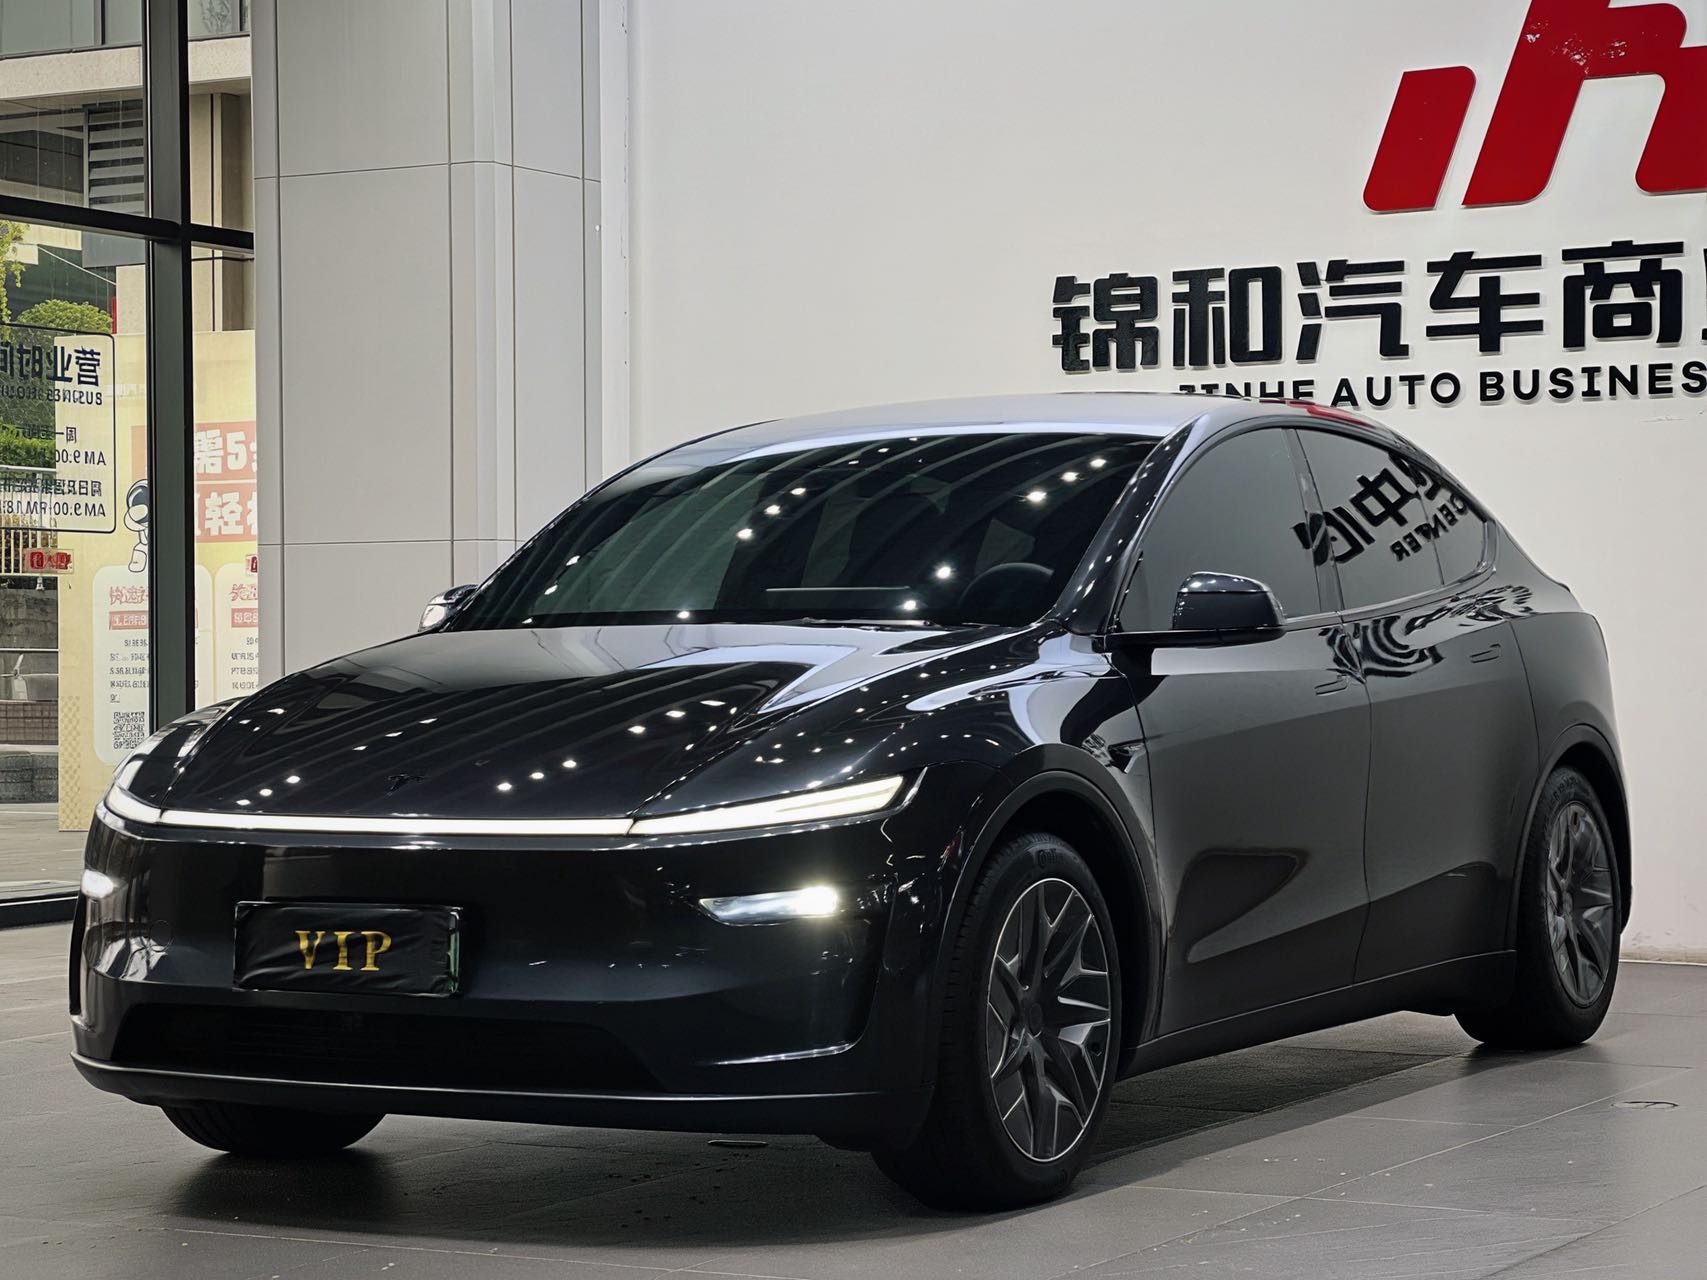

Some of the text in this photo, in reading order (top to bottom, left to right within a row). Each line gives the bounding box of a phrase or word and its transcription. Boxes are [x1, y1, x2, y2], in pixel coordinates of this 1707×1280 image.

[1053, 240, 1707, 371] 锦和汽车商
[1330, 372, 1461, 407] AUTO
[1479, 361, 1707, 402] BUSINES
[295, 930, 392, 971] VIP
